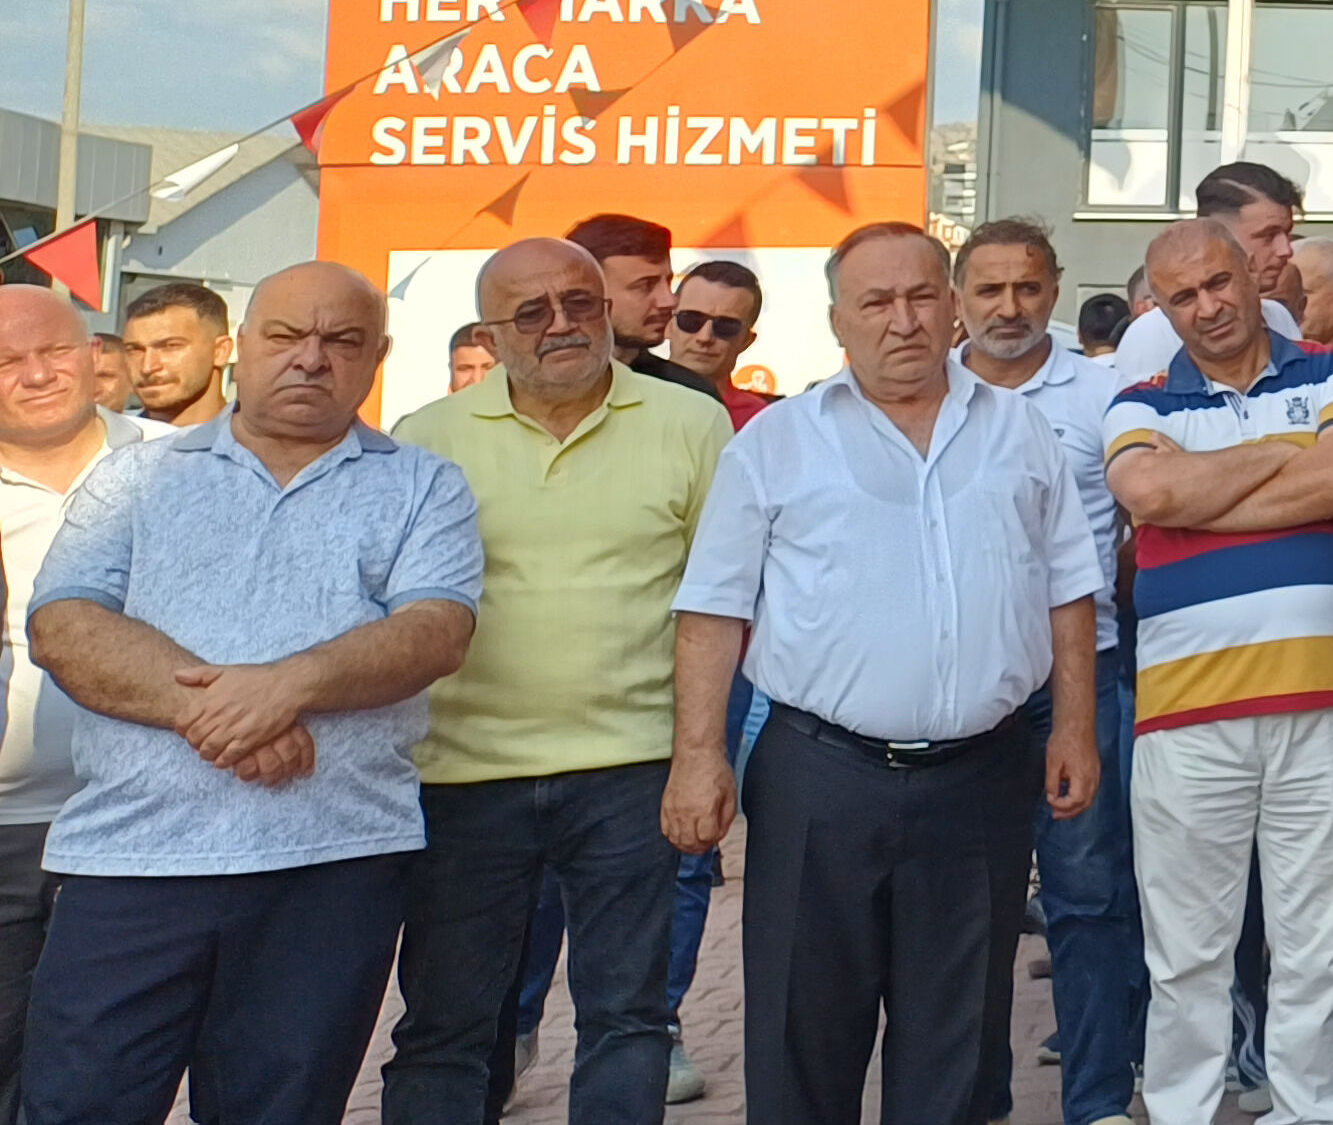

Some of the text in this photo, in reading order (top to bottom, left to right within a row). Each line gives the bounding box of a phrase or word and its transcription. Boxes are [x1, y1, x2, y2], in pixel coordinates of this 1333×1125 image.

[372, 43, 601, 95] ARACA
[369, 105, 878, 166] SERVİS HİZMETİ
